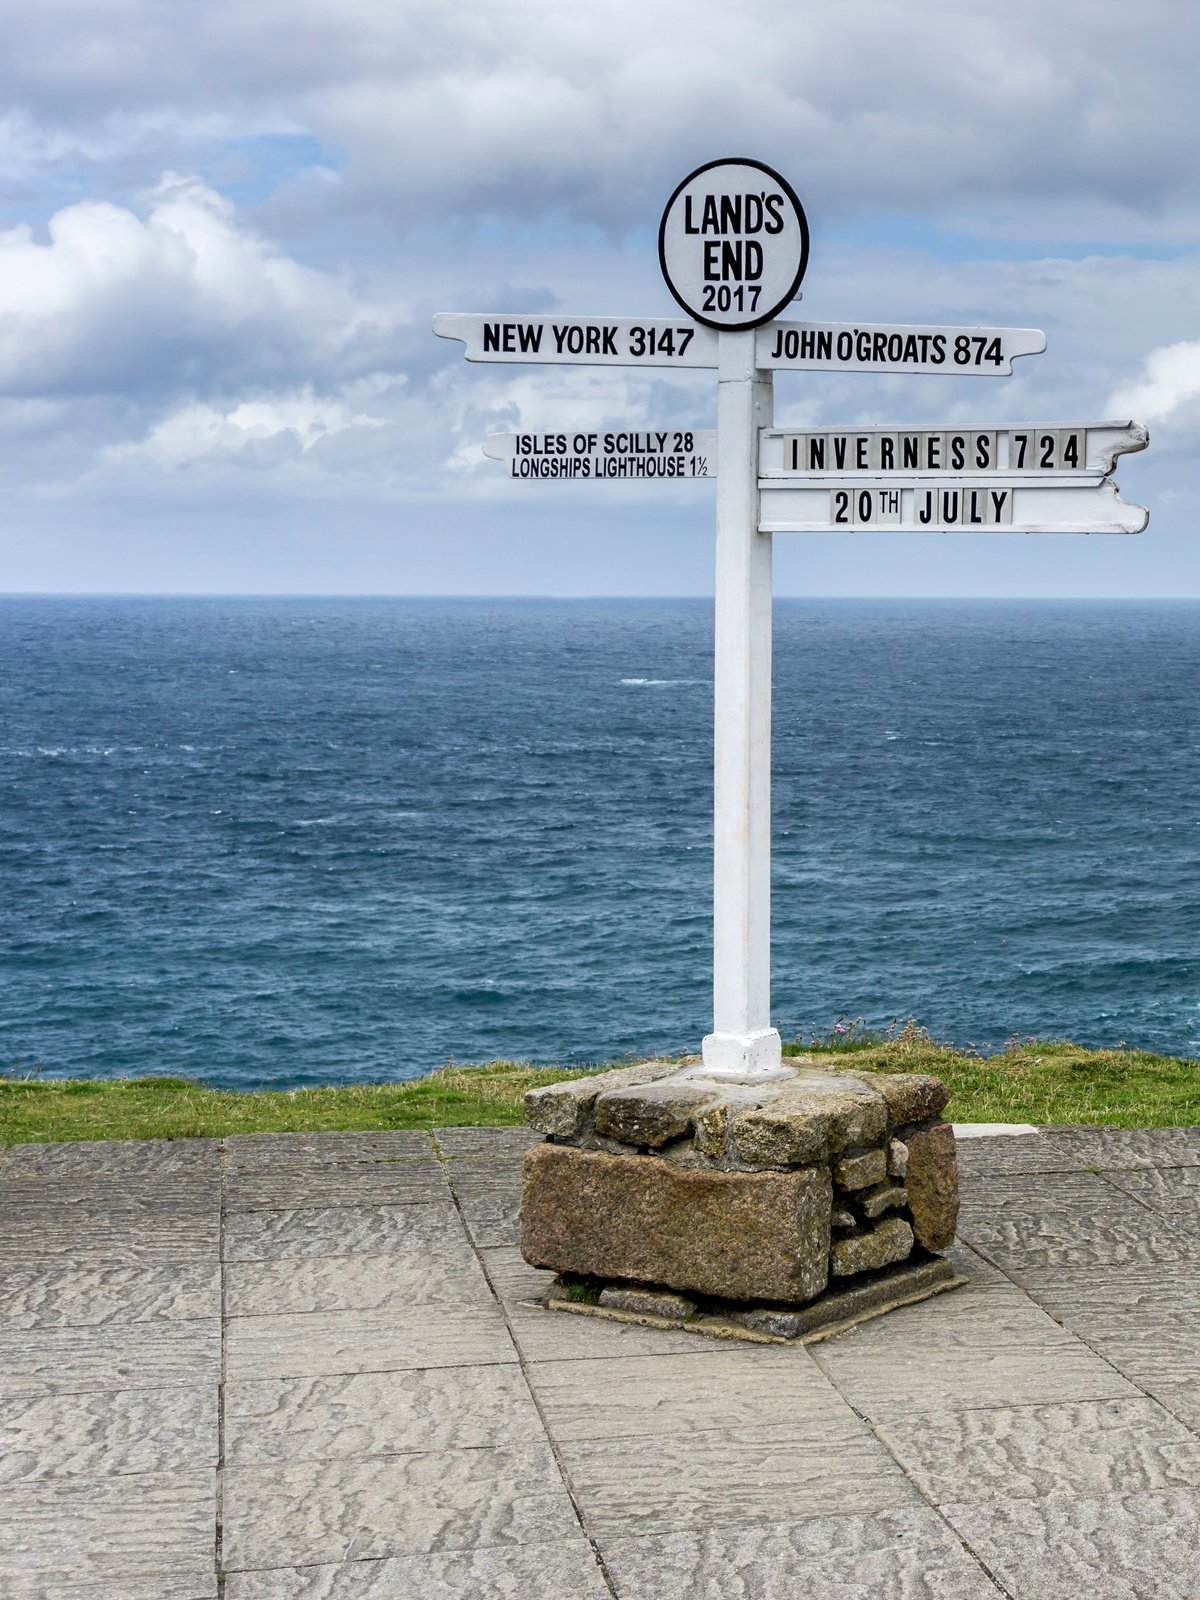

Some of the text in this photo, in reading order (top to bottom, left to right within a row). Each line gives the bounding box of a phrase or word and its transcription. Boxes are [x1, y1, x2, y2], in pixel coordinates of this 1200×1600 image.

[685, 192, 784, 234] LAND'S
[704, 240, 763, 281] END
[702, 285, 762, 312] 2017
[483, 323, 695, 356] NEW YORK 3147
[771, 328, 1004, 366] JOHN O'GROATS 874
[515, 432, 694, 455] ISLES OF SCILLY 28
[792, 434, 1079, 470] INVERNESS 724
[511, 457, 590, 478] LONGSHIPS
[595, 457, 685, 477] LIGHTHOUSE
[835, 490, 1007, 524] 20TH JULY
